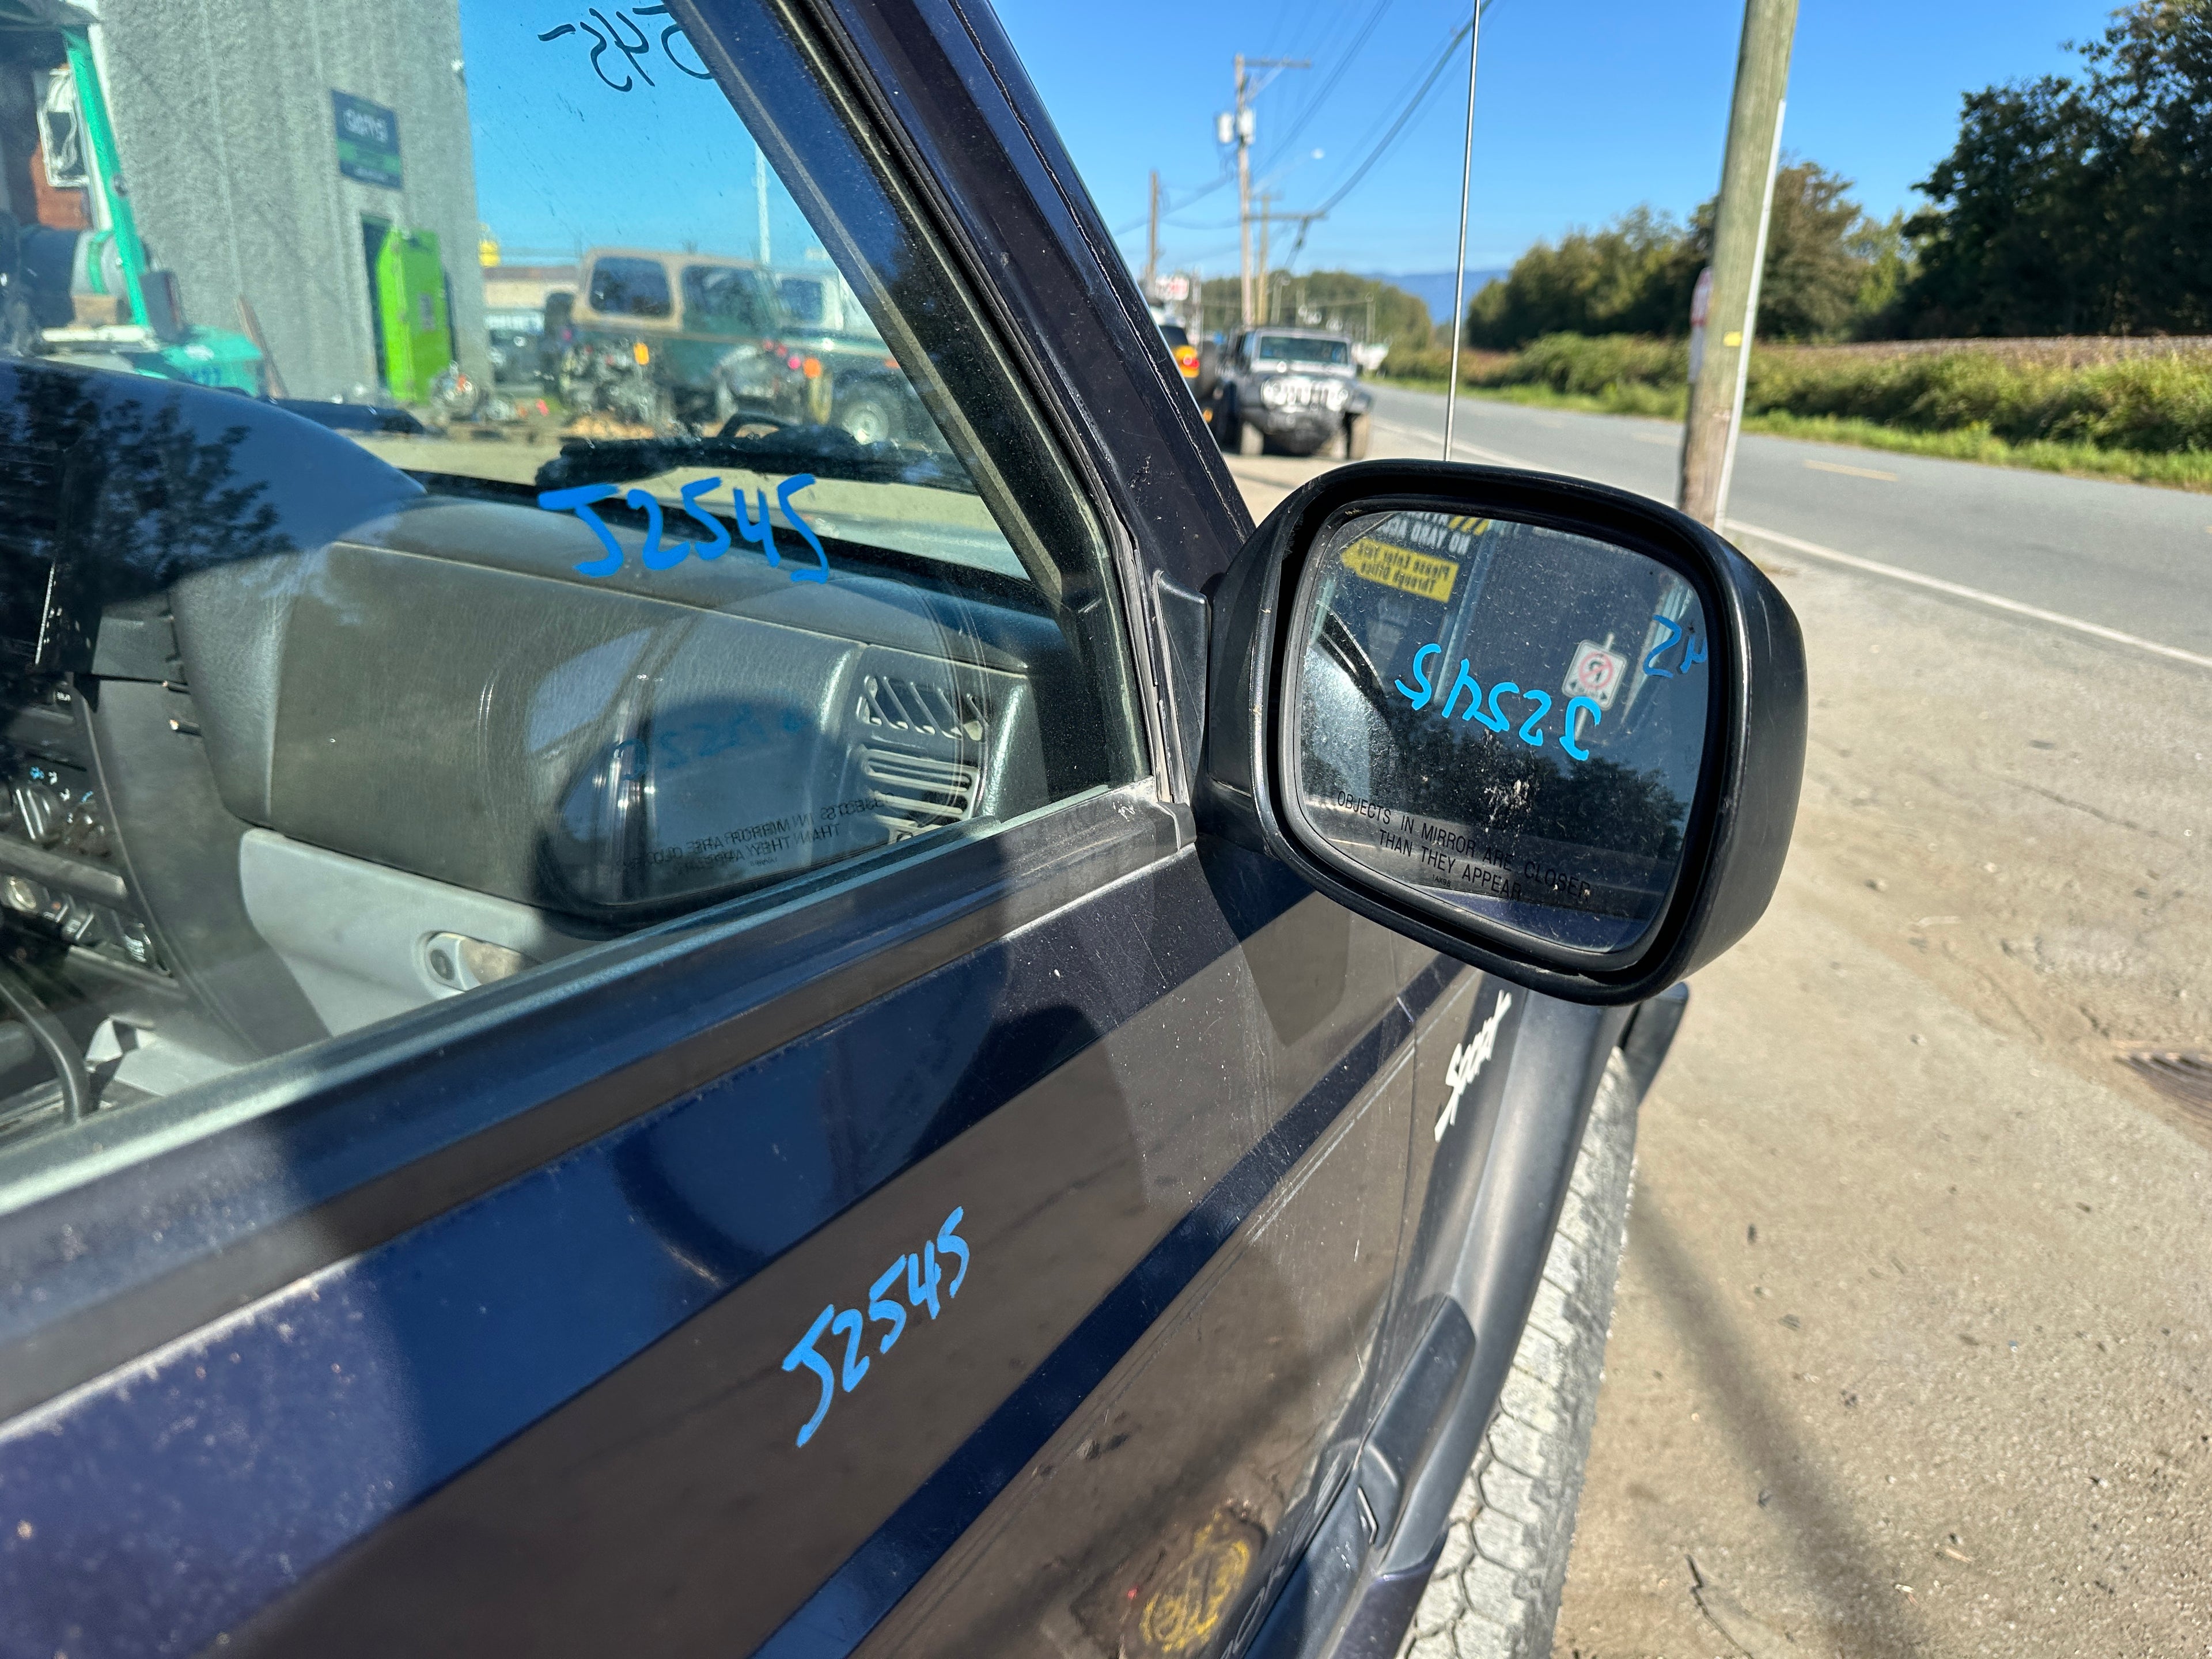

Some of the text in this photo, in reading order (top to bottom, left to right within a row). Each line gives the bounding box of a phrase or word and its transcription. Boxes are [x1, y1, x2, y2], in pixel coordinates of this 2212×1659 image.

[537, 474, 830, 584] J2545
[1338, 790, 1592, 900] OBJECTS IN MIRROR ARE CLOSER
[1380, 829, 1522, 900] THAN THEY APPEAR
[781, 1205, 970, 1448] J2545
